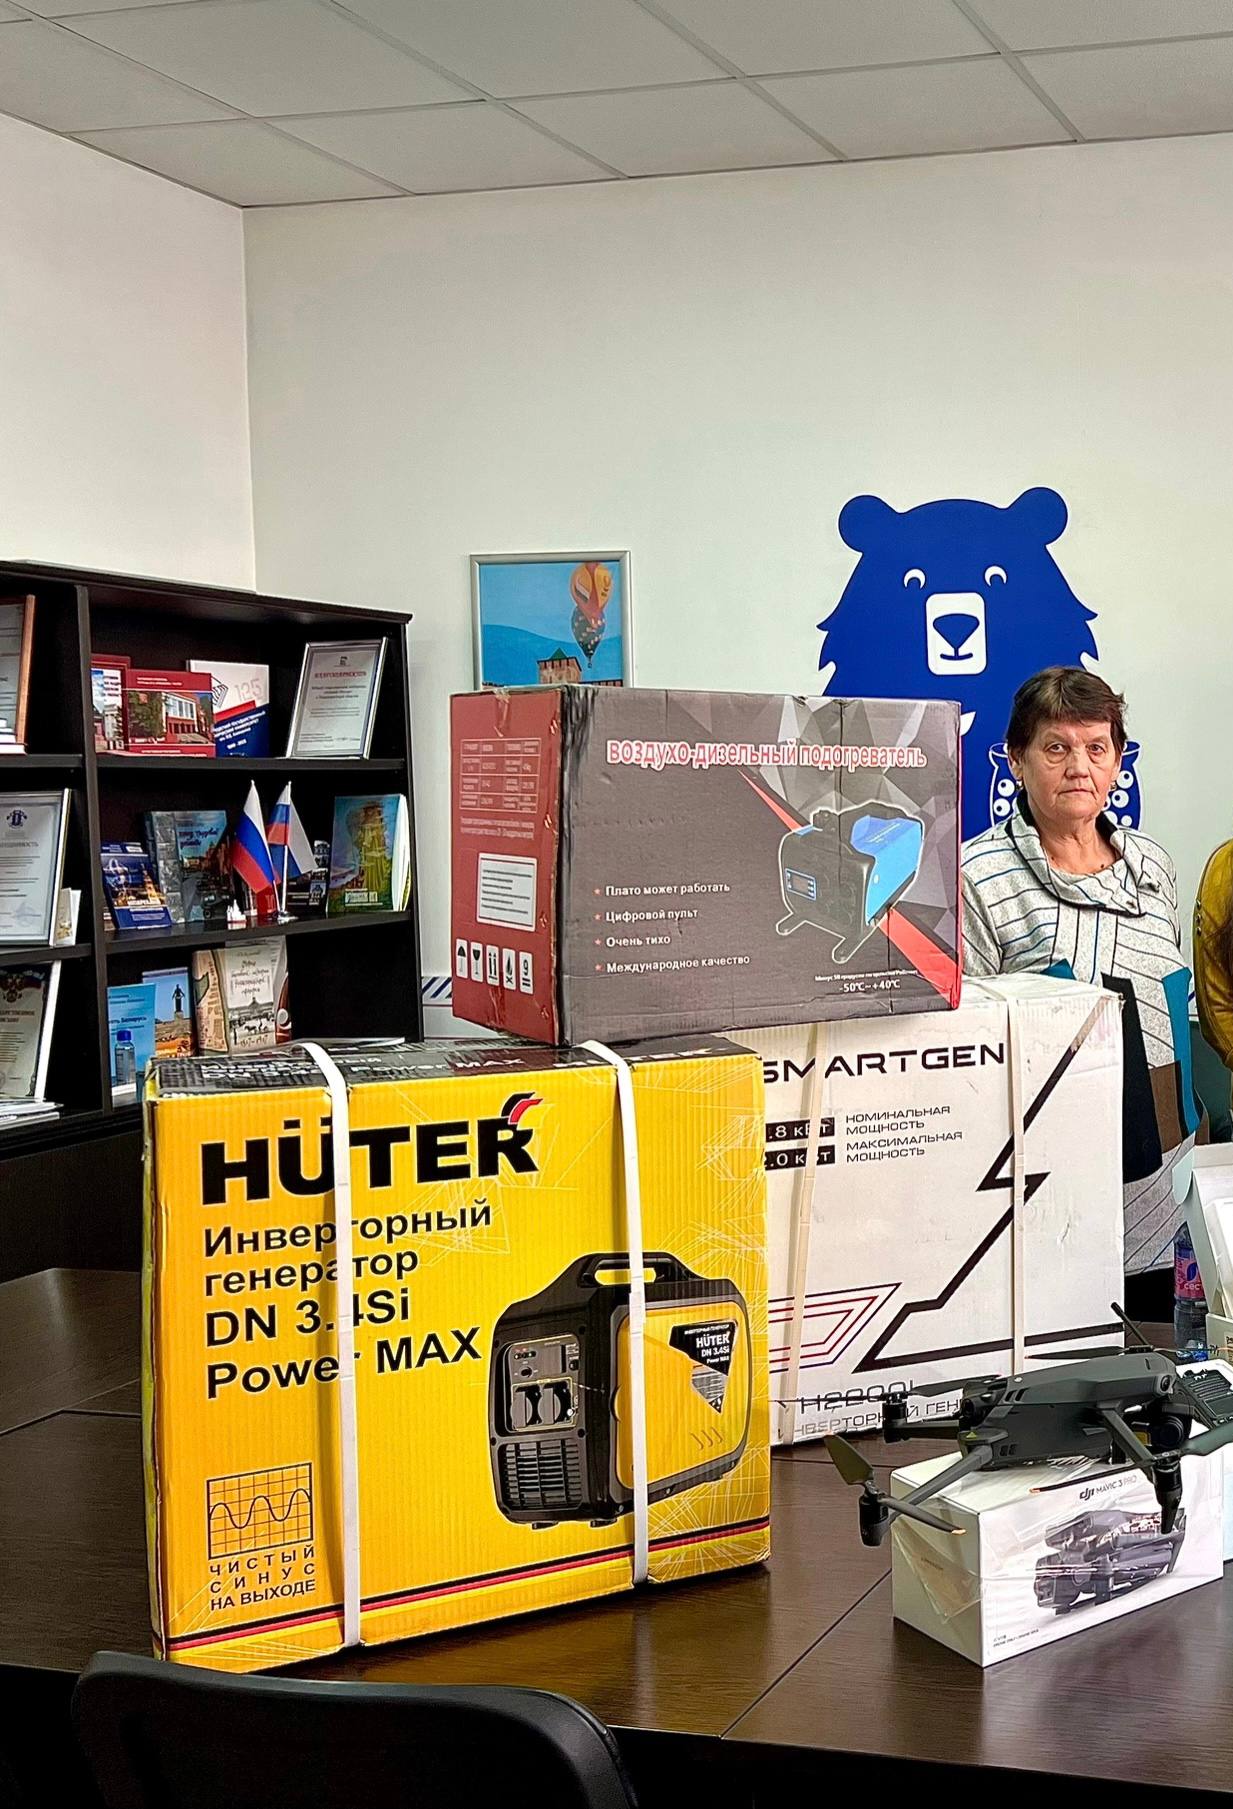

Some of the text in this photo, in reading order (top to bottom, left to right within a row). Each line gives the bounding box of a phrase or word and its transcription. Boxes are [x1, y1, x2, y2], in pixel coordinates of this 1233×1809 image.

[800, 745, 927, 772] подогреватель
[606, 882, 730, 896] Плато может работать
[606, 909, 698, 924] Цифровой пульт
[606, 936, 671, 948] Очень тихо
[606, 956, 750, 974] Международное качество
[764, 1043, 1004, 1084] SMARTGEN
[846, 1105, 950, 1124] НОМИНАЛЬНАЯ
[846, 1120, 924, 1136] МОЩНОСТЬ
[200, 1092, 541, 1206] HÜTER
[846, 1132, 962, 1151] МАКСИМАЛЬНАЯ
[764, 1150, 832, 1167] .0 кт
[846, 1148, 925, 1164] МОЩНОСТЬ
[204, 1198, 493, 1258] Инверорный
[205, 1247, 419, 1298] генератор
[206, 1308, 278, 1348] DN
[696, 1331, 730, 1348] HÜTER
[701, 1346, 730, 1358] DN 3.4Si
[207, 1326, 481, 1400] Powe MAX
[926, 1398, 962, 1416] ГЕН
[1096, 1480, 1117, 1494] MAVIC
[1118, 1480, 1122, 1488] 3
[1124, 1474, 1137, 1486] PRO
[210, 1544, 314, 1577] ЧИСТЫЙ
[210, 1563, 315, 1594] СИНУС
[210, 1579, 316, 1611] НА ВЫХОДЕ
